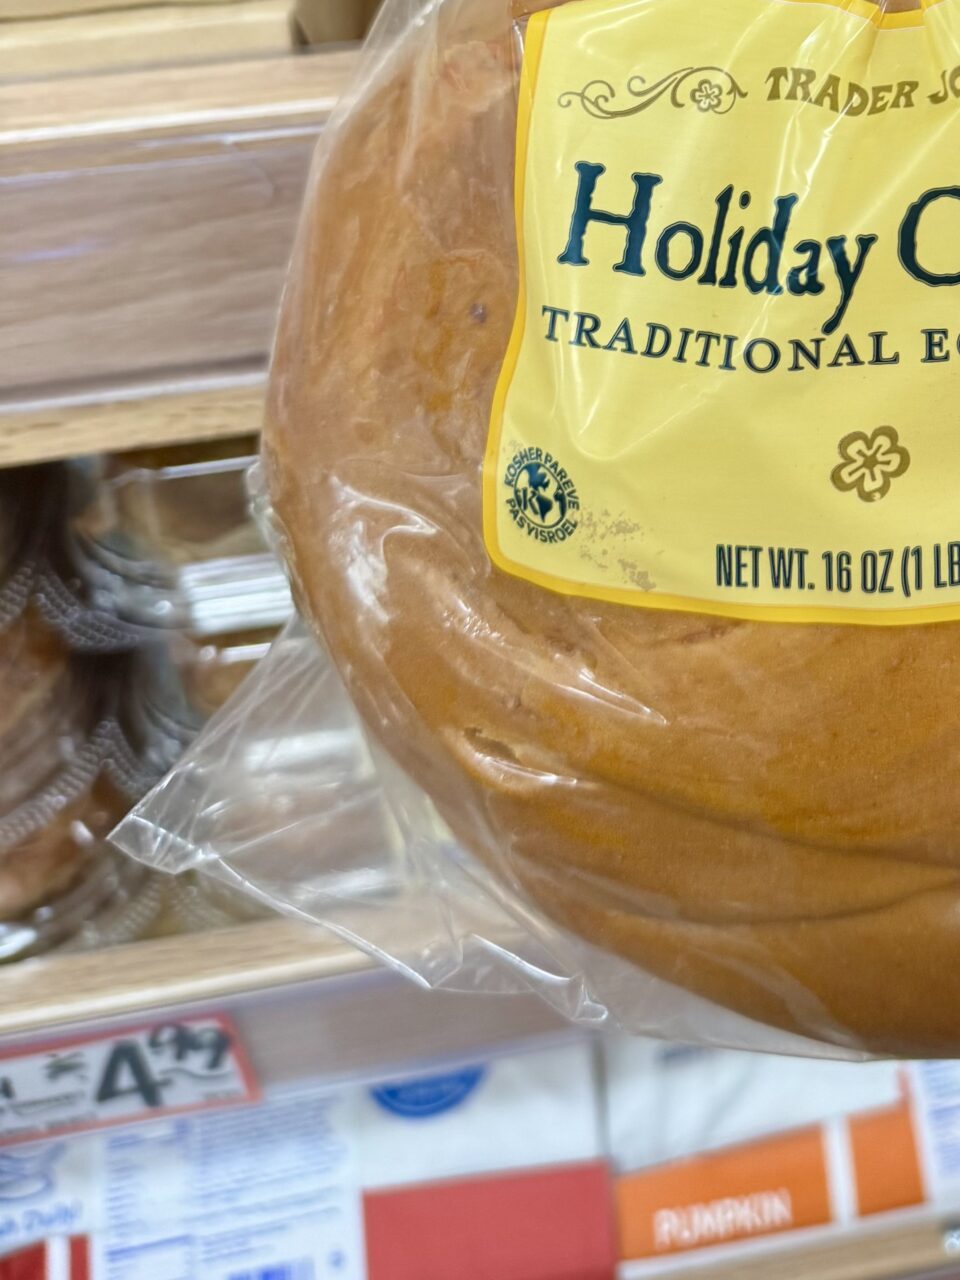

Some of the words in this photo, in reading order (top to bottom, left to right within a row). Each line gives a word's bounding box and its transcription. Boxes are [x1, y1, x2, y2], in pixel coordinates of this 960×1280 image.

[765, 66, 919, 117] TRADER
[556, 160, 879, 335] Holiday
[541, 305, 899, 373] TRADITIONAL
[504, 446, 543, 488] KOSHER
[543, 452, 581, 511] PAREVE
[716, 543, 763, 587] NET
[768, 546, 816, 590] WT.
[821, 550, 853, 593] 16
[860, 548, 895, 593] OZ
[900, 545, 923, 598] (1
[654, 1186, 793, 1252] PUMPKIN
